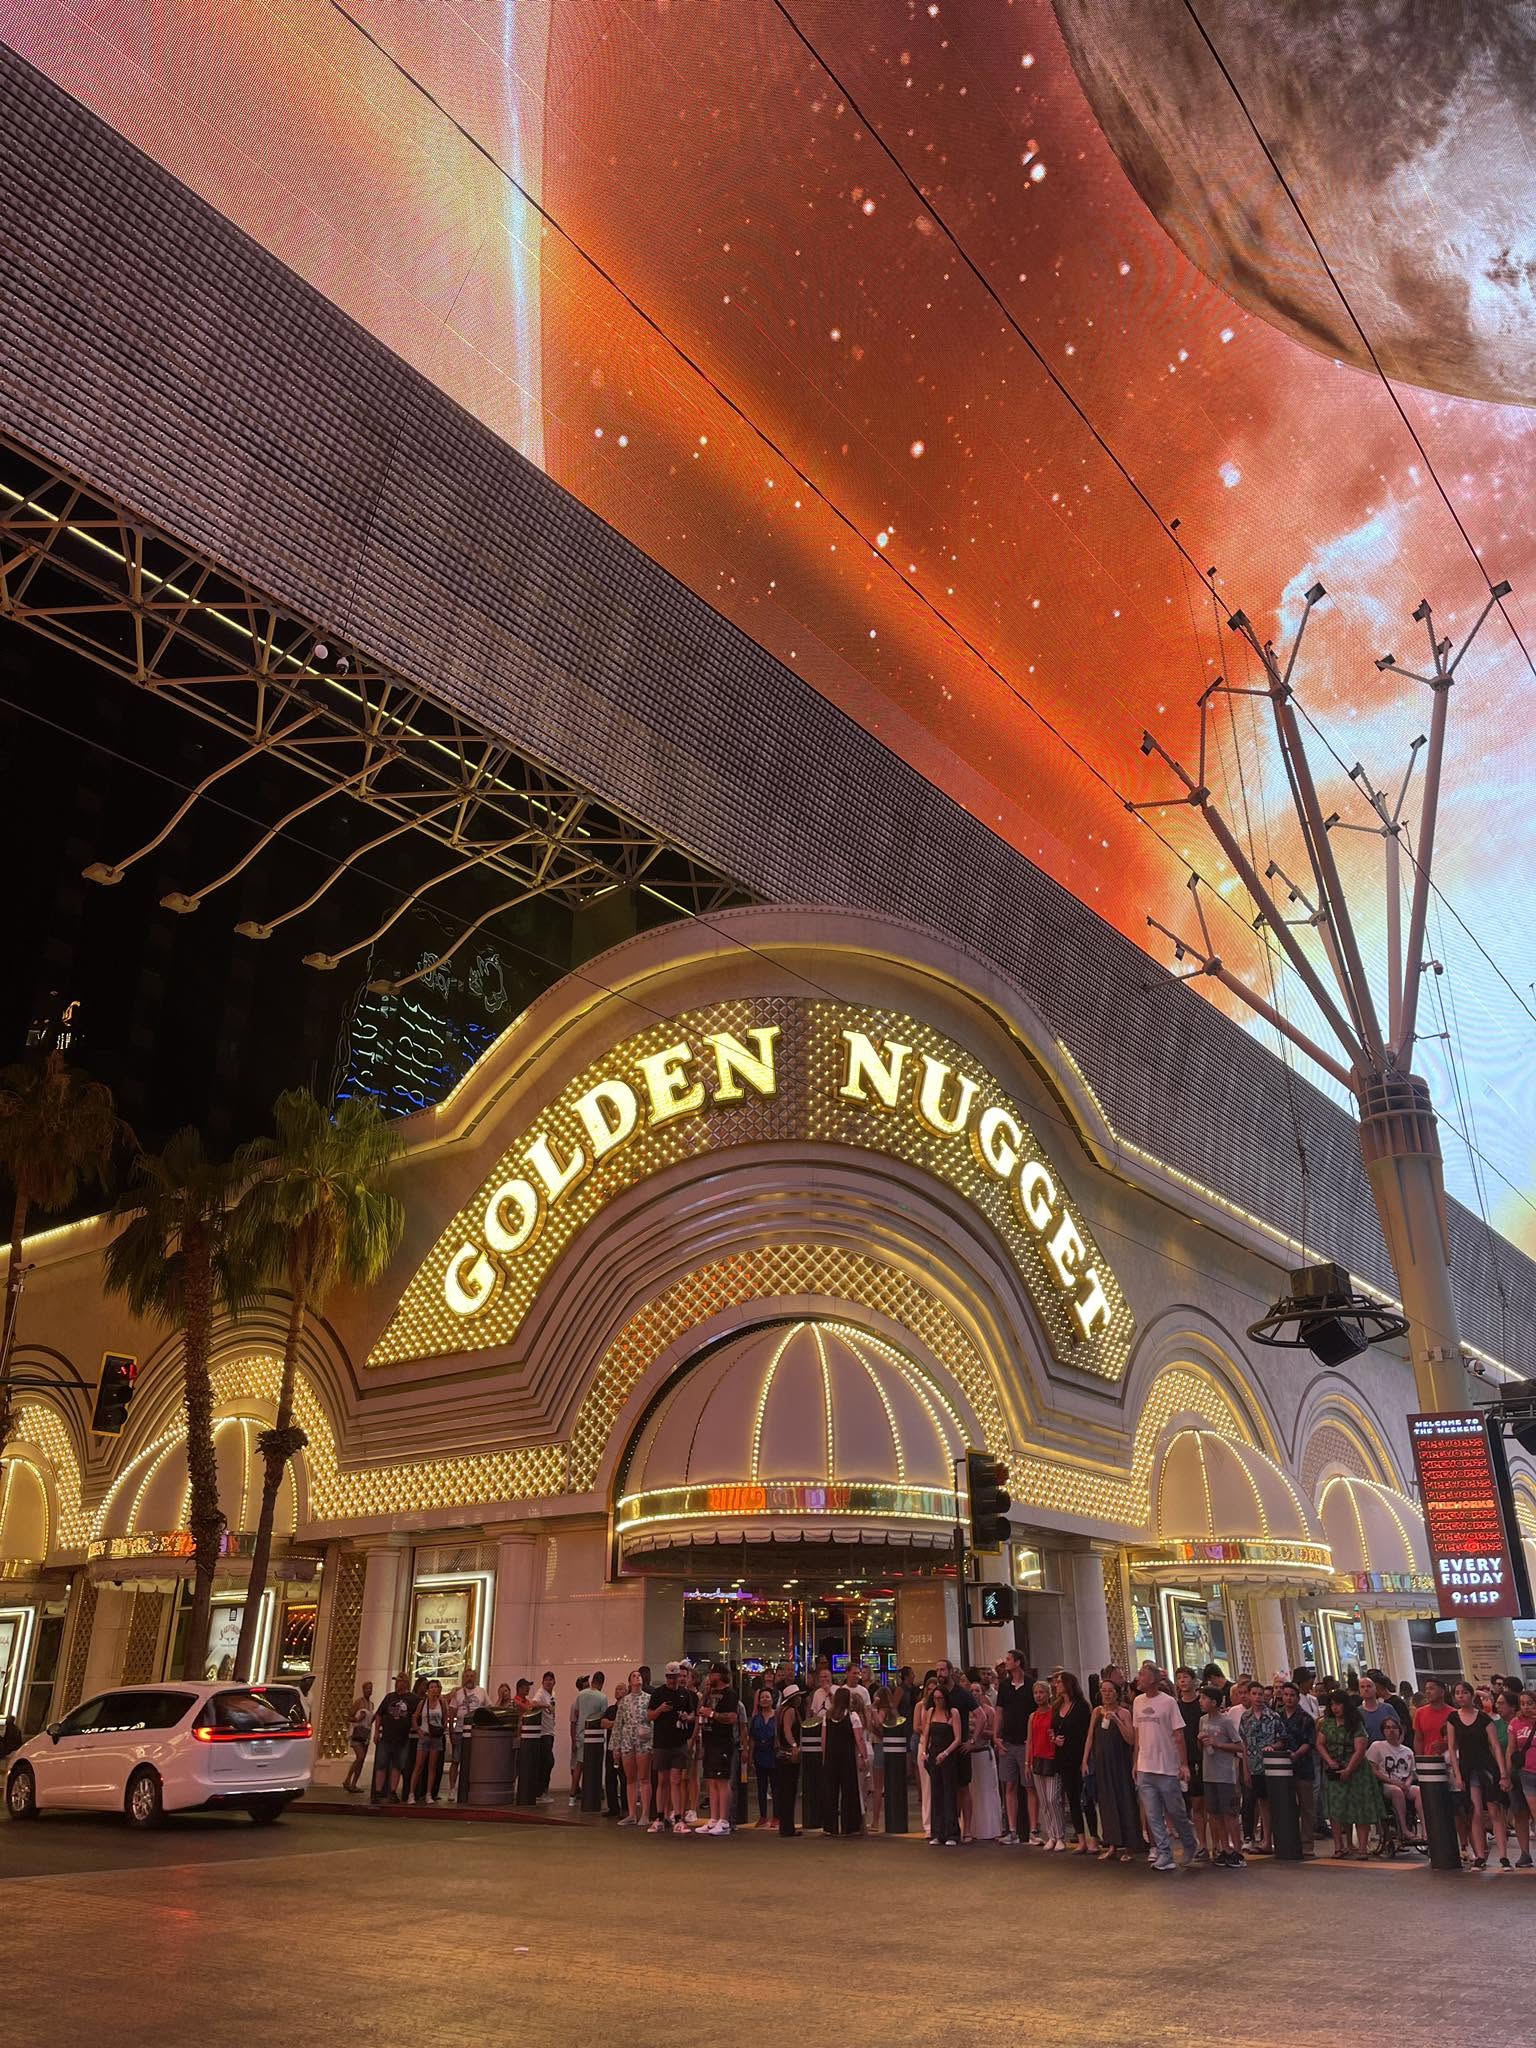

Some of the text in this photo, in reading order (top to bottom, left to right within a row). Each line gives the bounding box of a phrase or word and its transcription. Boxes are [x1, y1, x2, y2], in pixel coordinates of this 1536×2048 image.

[444, 1025, 1113, 1341] GOLDEN NUGGET
[1415, 1420, 1462, 1428] WELCOME
[1437, 1425, 1483, 1434] WEEKEND
[1428, 1500, 1496, 1510] FIREWORKS
[1439, 1557, 1502, 1572] EVERY
[1441, 1572, 1504, 1585] FRIDAY
[1451, 1590, 1500, 1604] 9:15P
